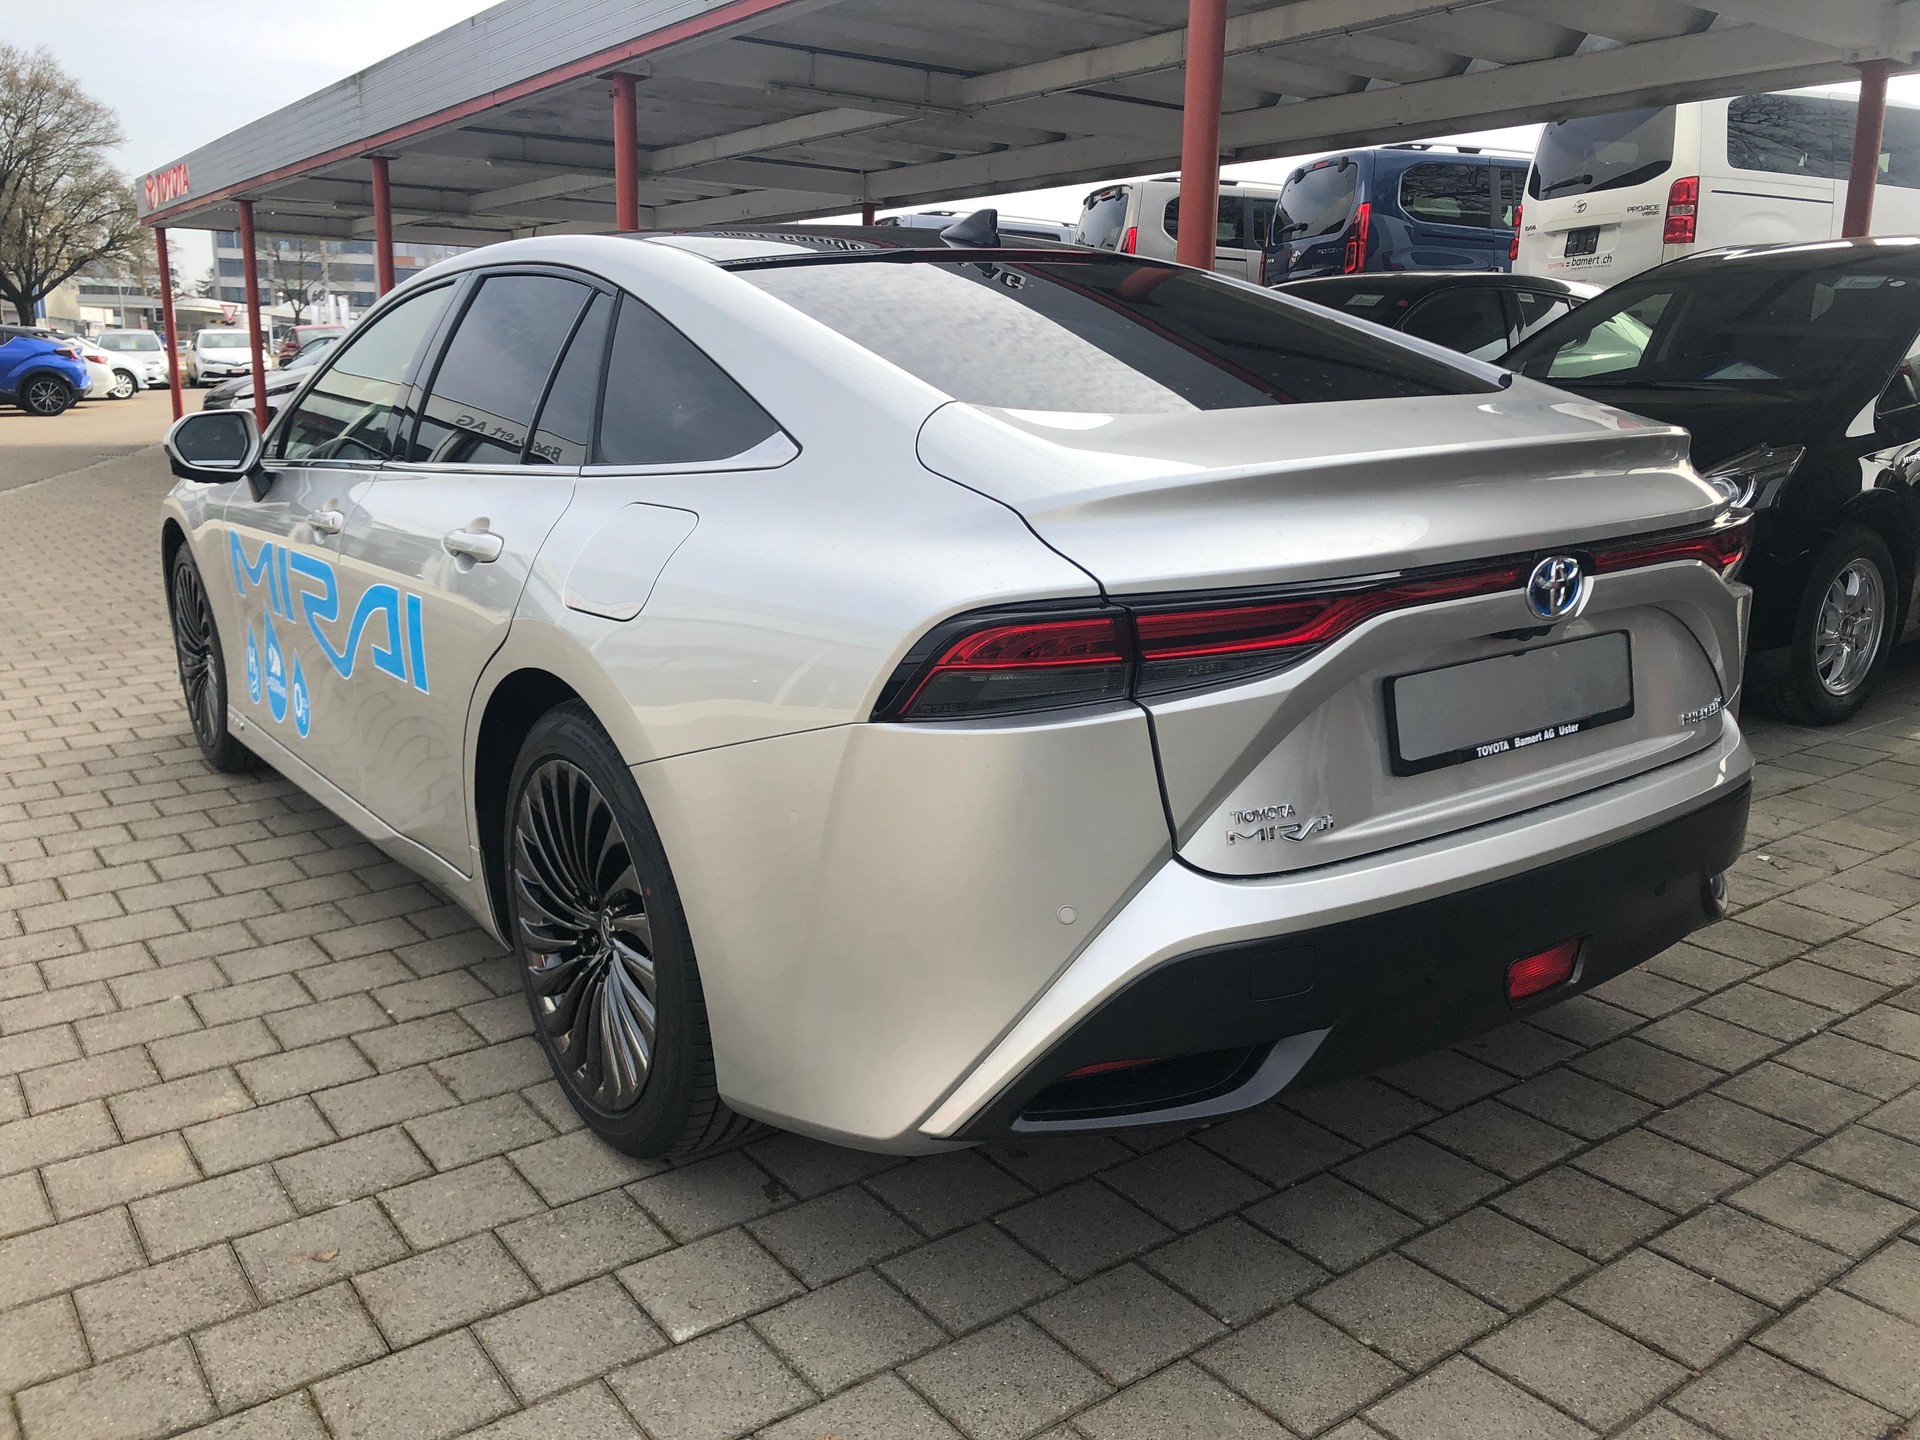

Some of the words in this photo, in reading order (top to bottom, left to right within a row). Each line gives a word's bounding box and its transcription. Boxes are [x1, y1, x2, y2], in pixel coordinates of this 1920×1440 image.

[155, 163, 190, 204] TOYOTA
[1626, 203, 1661, 213] PROACE
[229, 528, 430, 696] MIRAI
[1475, 740, 1510, 758] TOYOTA
[1513, 731, 1543, 748] Bamert
[1543, 728, 1556, 740] AG
[1558, 723, 1580, 736] Uster
[1225, 813, 1334, 846] MIRAI
[1230, 803, 1297, 825] TOYOTA
